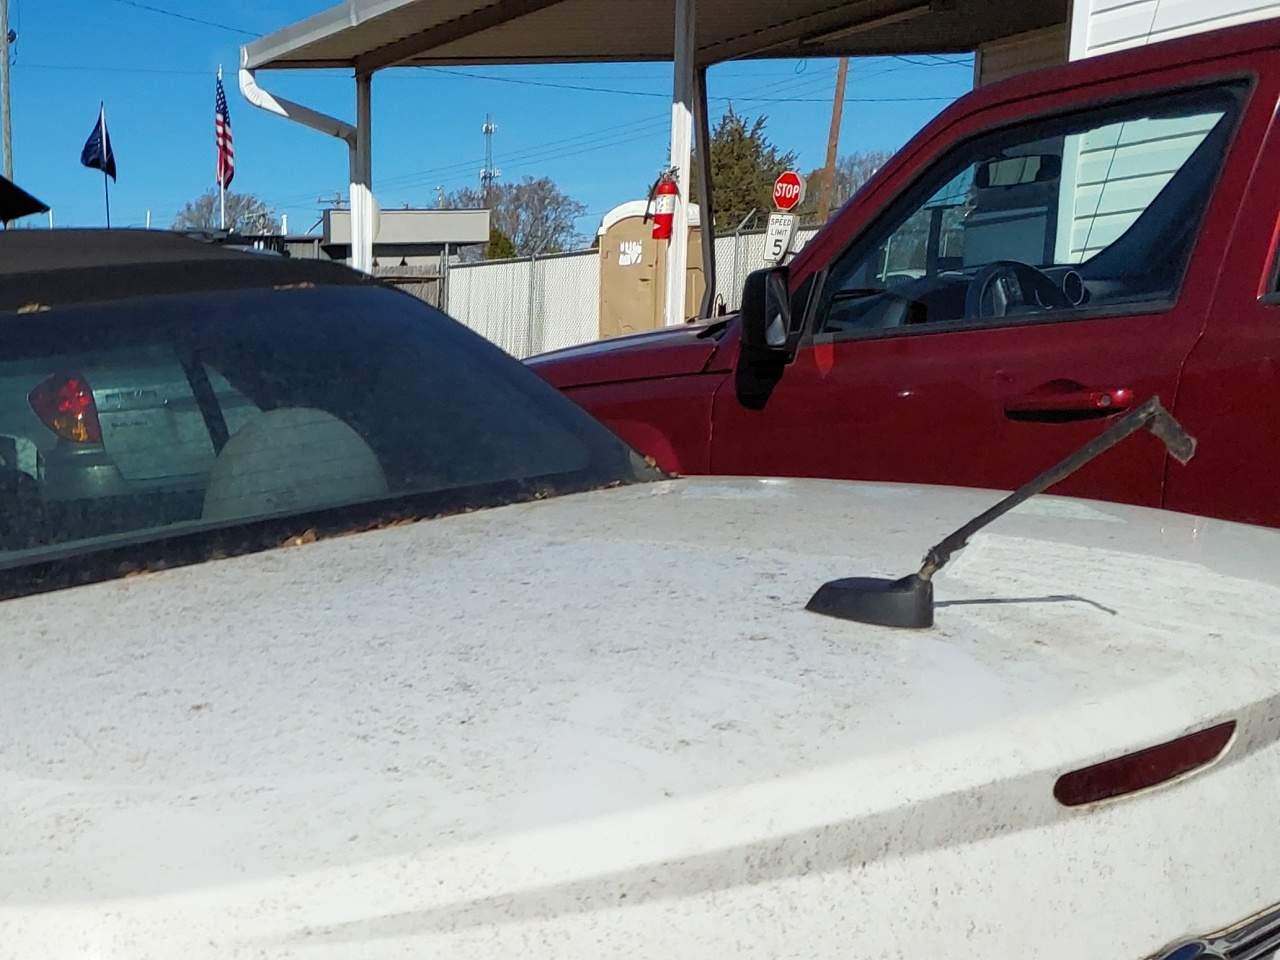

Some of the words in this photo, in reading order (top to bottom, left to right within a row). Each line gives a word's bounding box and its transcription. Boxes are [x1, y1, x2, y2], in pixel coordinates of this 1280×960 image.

[775, 182, 800, 199] STOP
[770, 218, 792, 227] SPEED
[770, 229, 788, 237] LIMIT
[772, 239, 784, 256] 5
